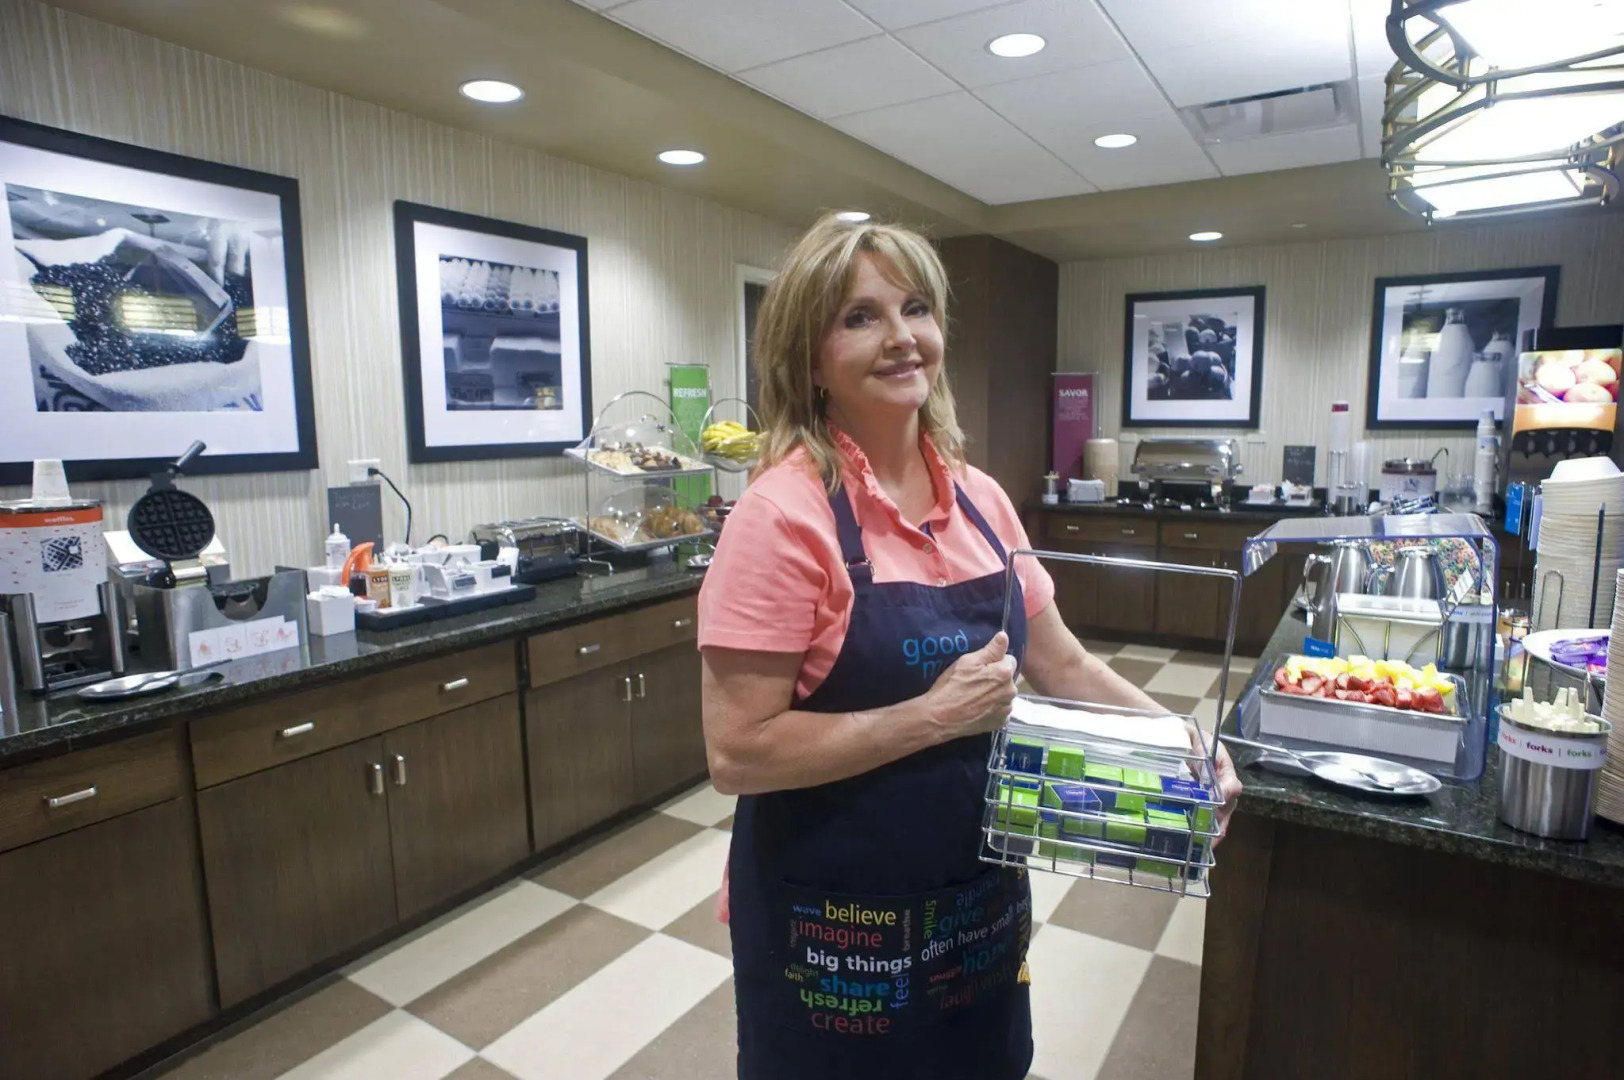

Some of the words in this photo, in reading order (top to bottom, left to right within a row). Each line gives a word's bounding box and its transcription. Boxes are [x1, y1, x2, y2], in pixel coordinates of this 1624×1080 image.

[672, 388, 707, 398] REFRESH
[1058, 389, 1089, 397] SAVOR
[902, 629, 969, 666] good
[1526, 742, 1553, 754] forks
[1567, 749, 1592, 758] forks
[793, 904, 822, 917] wave
[825, 899, 897, 926] believe
[923, 899, 938, 940] smile
[938, 905, 984, 938] give
[798, 916, 884, 950] imagine
[806, 946, 839, 972] big
[845, 954, 912, 975] things
[921, 938, 954, 962] often
[958, 925, 988, 945] have
[990, 903, 1014, 935] small
[901, 908, 911, 952] breathe
[785, 967, 804, 983] faith
[820, 974, 891, 998] share
[800, 988, 883, 1017] refresh
[890, 971, 910, 1010] feel
[811, 1012, 891, 1035] create
